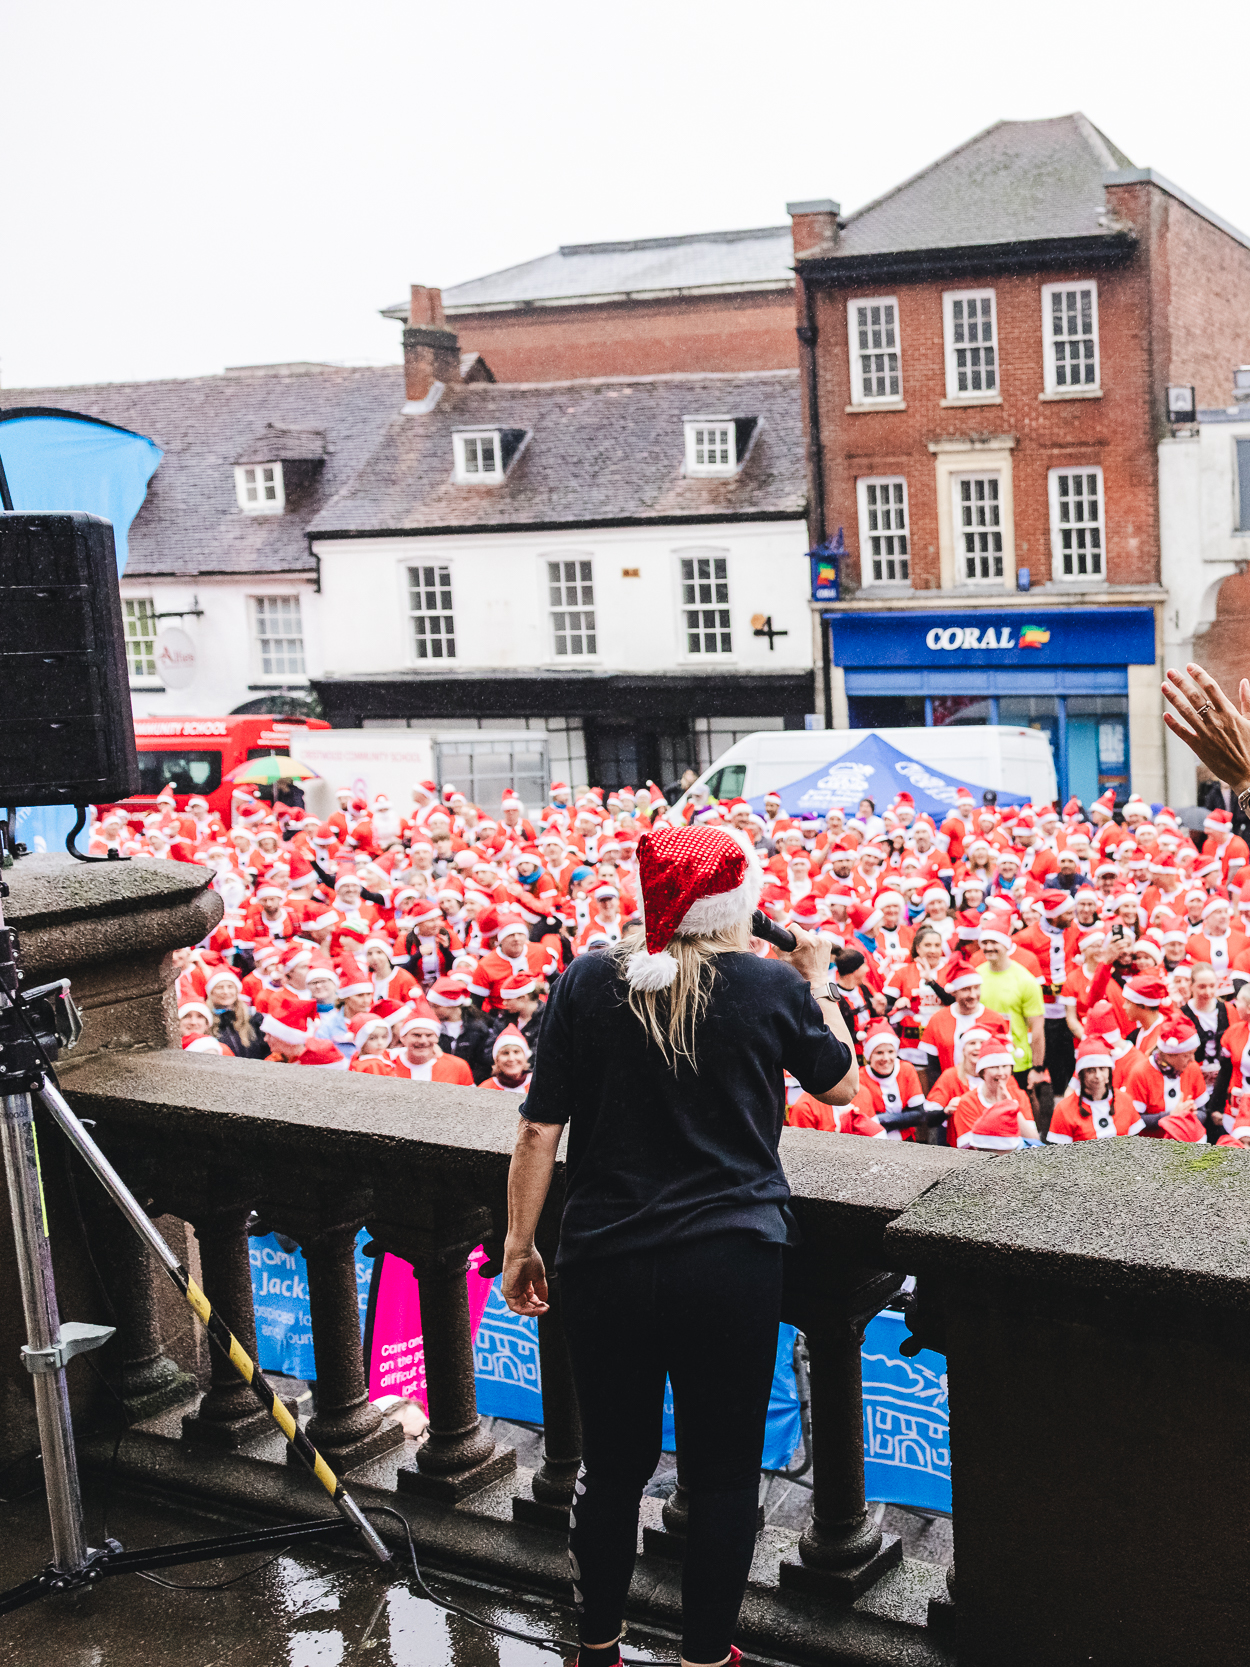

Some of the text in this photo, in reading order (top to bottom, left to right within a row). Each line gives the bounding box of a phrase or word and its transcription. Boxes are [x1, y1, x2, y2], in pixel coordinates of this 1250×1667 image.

[926, 626, 1016, 651] CORAL
[183, 721, 227, 735] SCHOOL
[260, 1272, 310, 1300] Jack
[381, 1342, 407, 1357] Care
[379, 1360, 394, 1373] on
[397, 1355, 413, 1368] the
